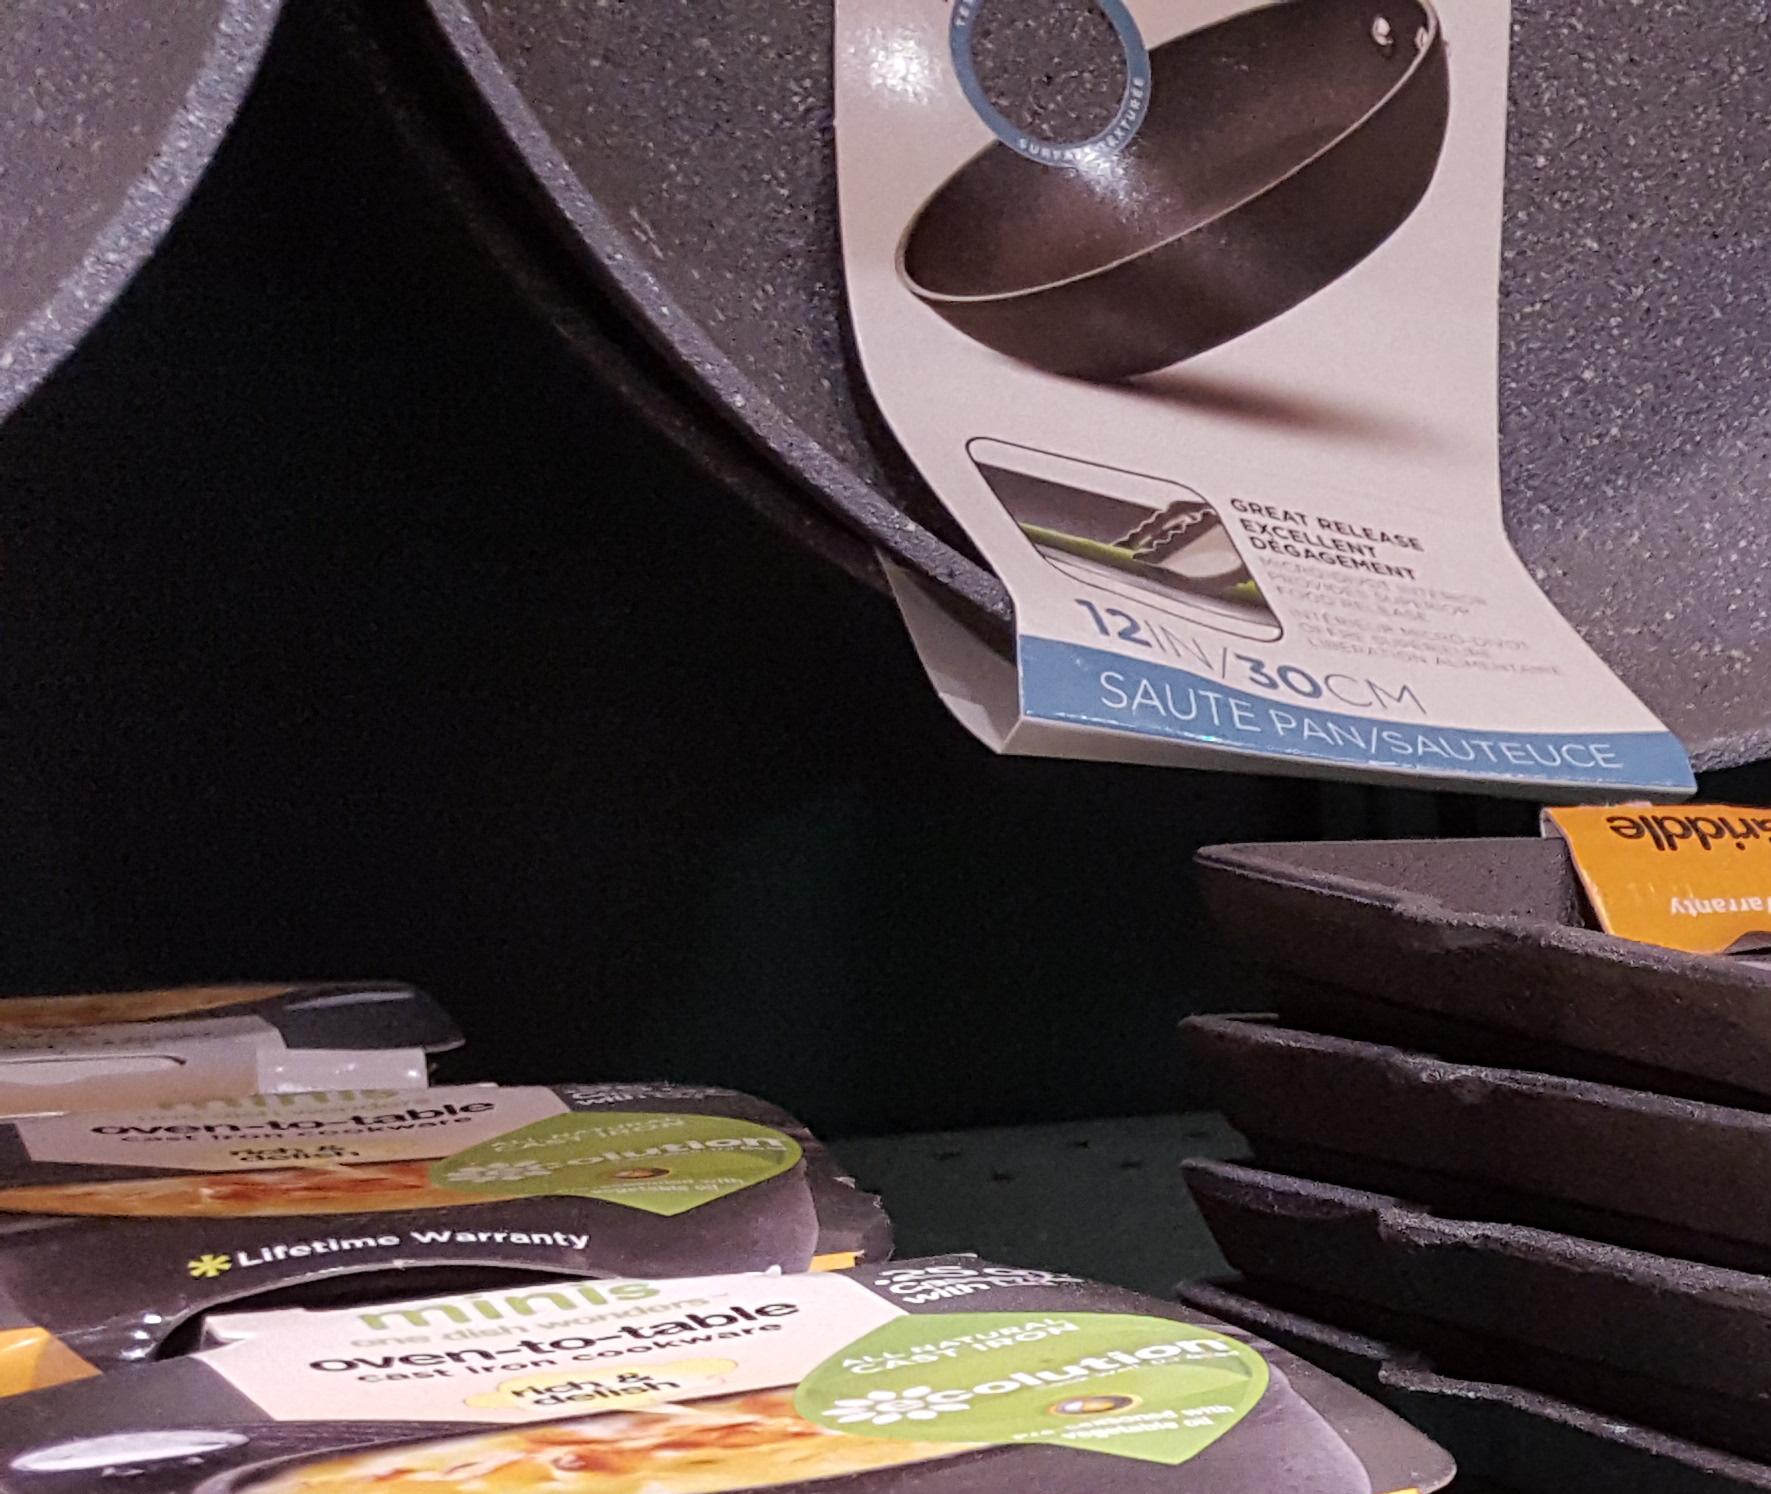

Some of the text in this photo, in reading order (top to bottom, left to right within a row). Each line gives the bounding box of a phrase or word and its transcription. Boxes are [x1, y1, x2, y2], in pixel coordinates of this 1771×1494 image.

[1230, 498, 1425, 552] GREAT RELEASE
[1240, 518, 1377, 559] EXCELLENT
[1074, 599, 1427, 714] 12IN/30CM
[1100, 671, 1258, 731] SAUTE
[91, 1100, 496, 1136] oven-to-table
[236, 1227, 591, 1269] Lifetime Warranty
[360, 1281, 660, 1331] minis
[442, 1322, 528, 1342] dish
[537, 1298, 710, 1332] wonders
[308, 1301, 800, 1374] oven-to-table
[357, 1322, 783, 1384] cast iron cookware
[850, 1321, 1081, 1376] CAST IRON
[905, 1316, 1071, 1355] NATURAL
[510, 1376, 605, 1399] rich
[532, 1378, 682, 1408] delish
